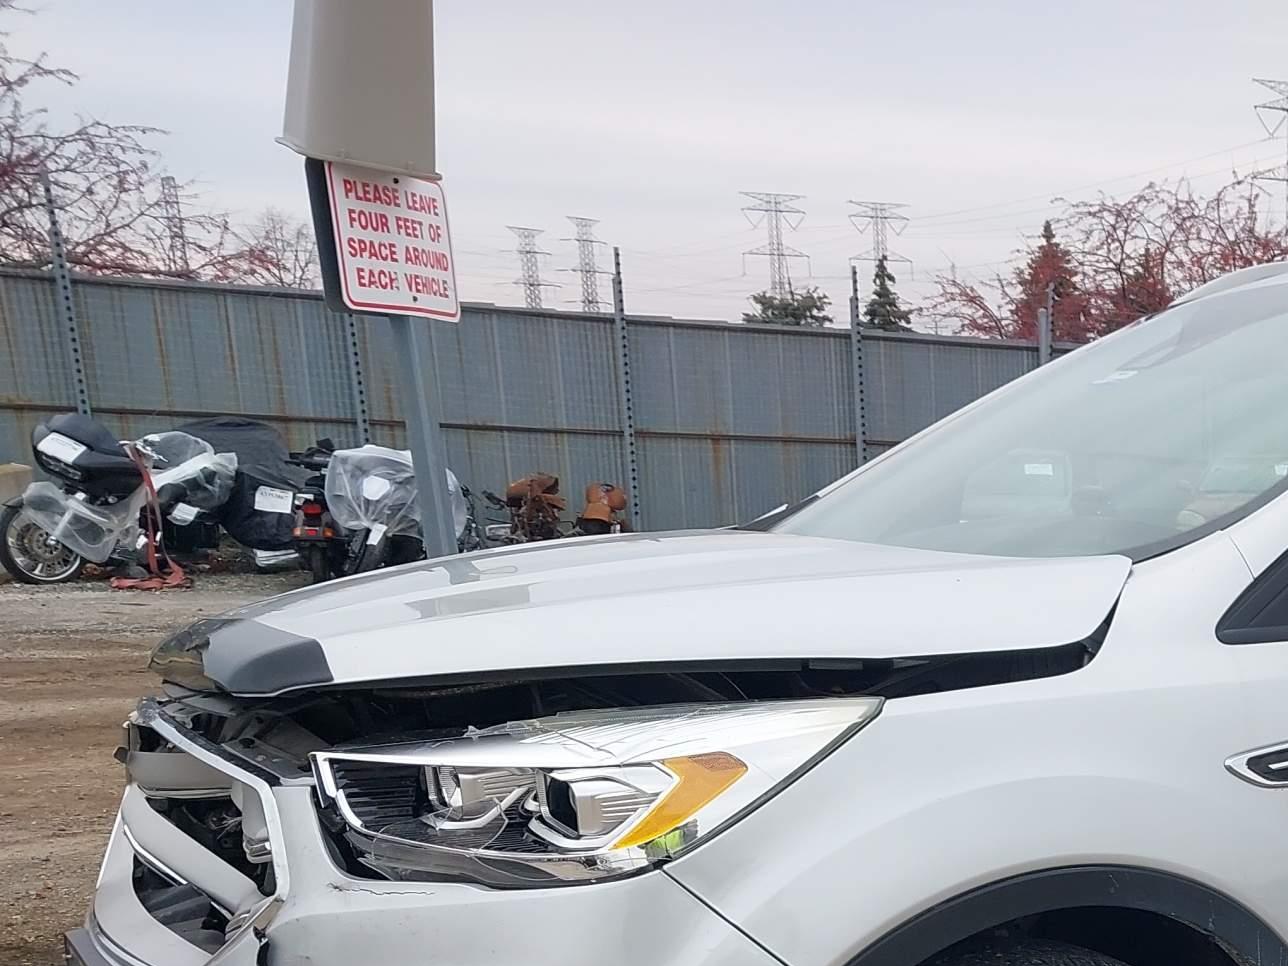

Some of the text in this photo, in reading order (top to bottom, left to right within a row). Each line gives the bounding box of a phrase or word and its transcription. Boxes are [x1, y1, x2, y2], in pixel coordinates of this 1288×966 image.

[343, 178, 439, 217] PLEASE LEAVE
[347, 208, 441, 244] FOUR FEET OF
[347, 237, 449, 272] SPACE AROUND
[356, 267, 449, 299] EACH VEHICLE
